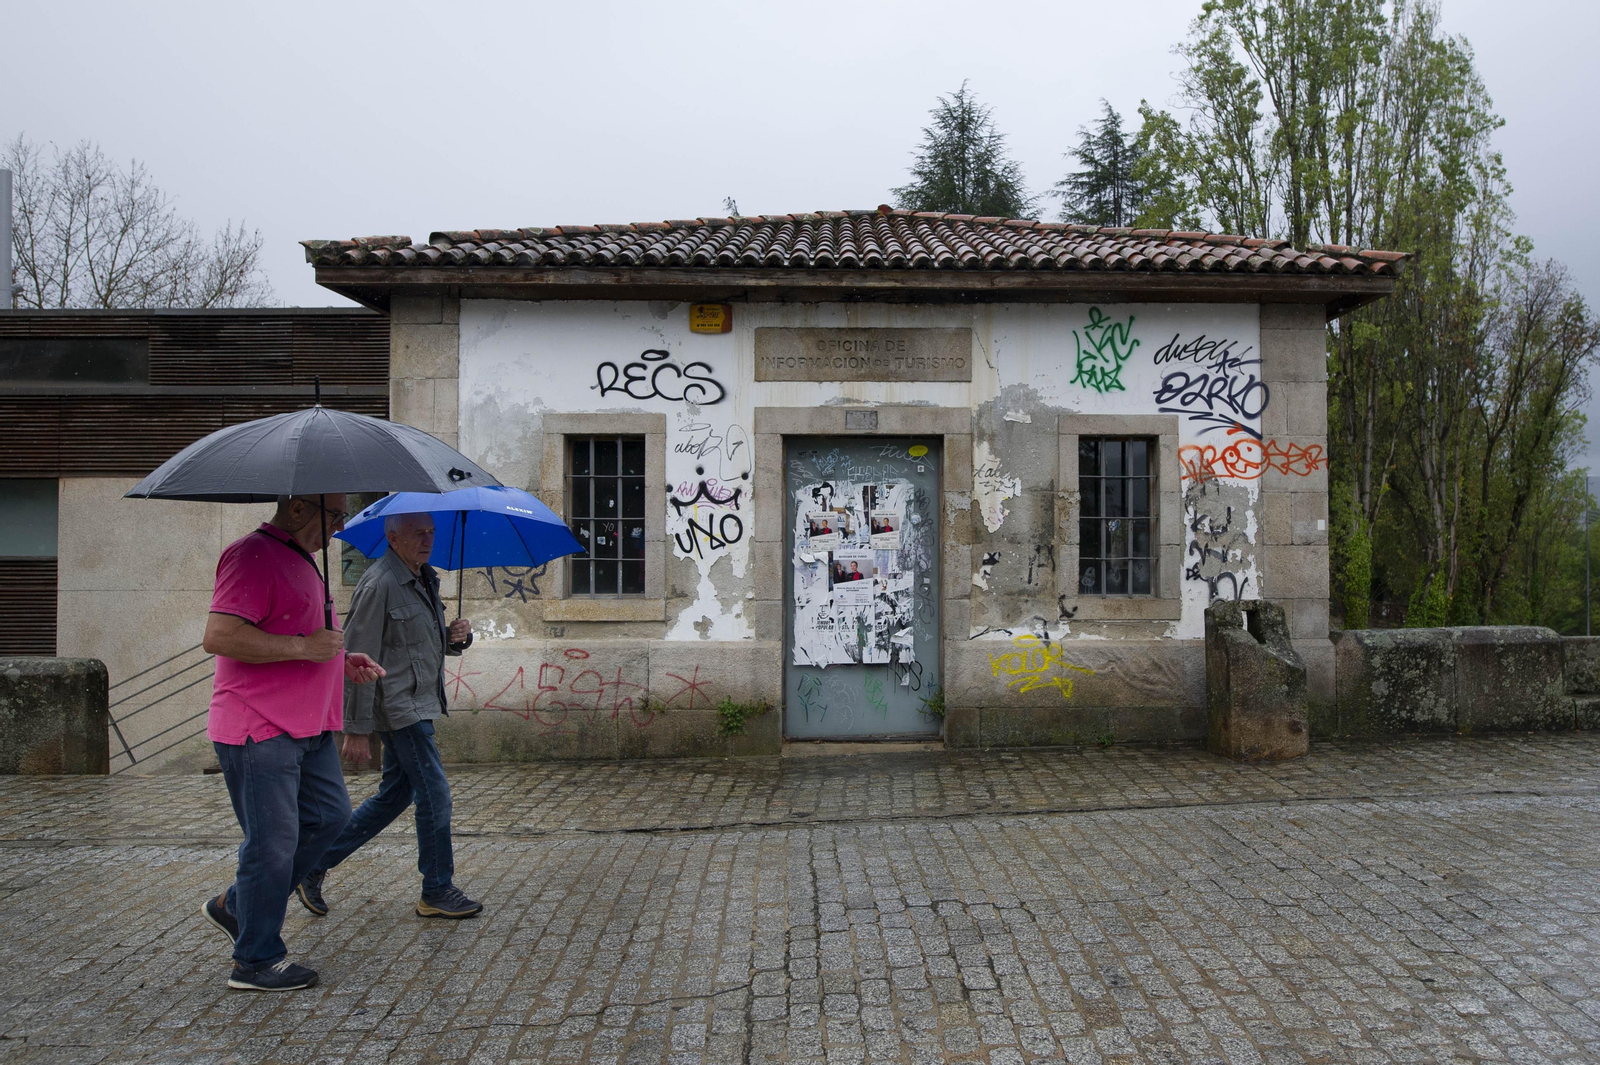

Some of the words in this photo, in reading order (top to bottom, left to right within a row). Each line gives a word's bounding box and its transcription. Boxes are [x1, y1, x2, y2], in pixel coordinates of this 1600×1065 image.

[816, 339, 881, 352] OFICINA
[885, 339, 906, 352] DE
[895, 356, 966, 370] TURISMO
[603, 522, 615, 533] YO
[675, 513, 743, 560] UNO
